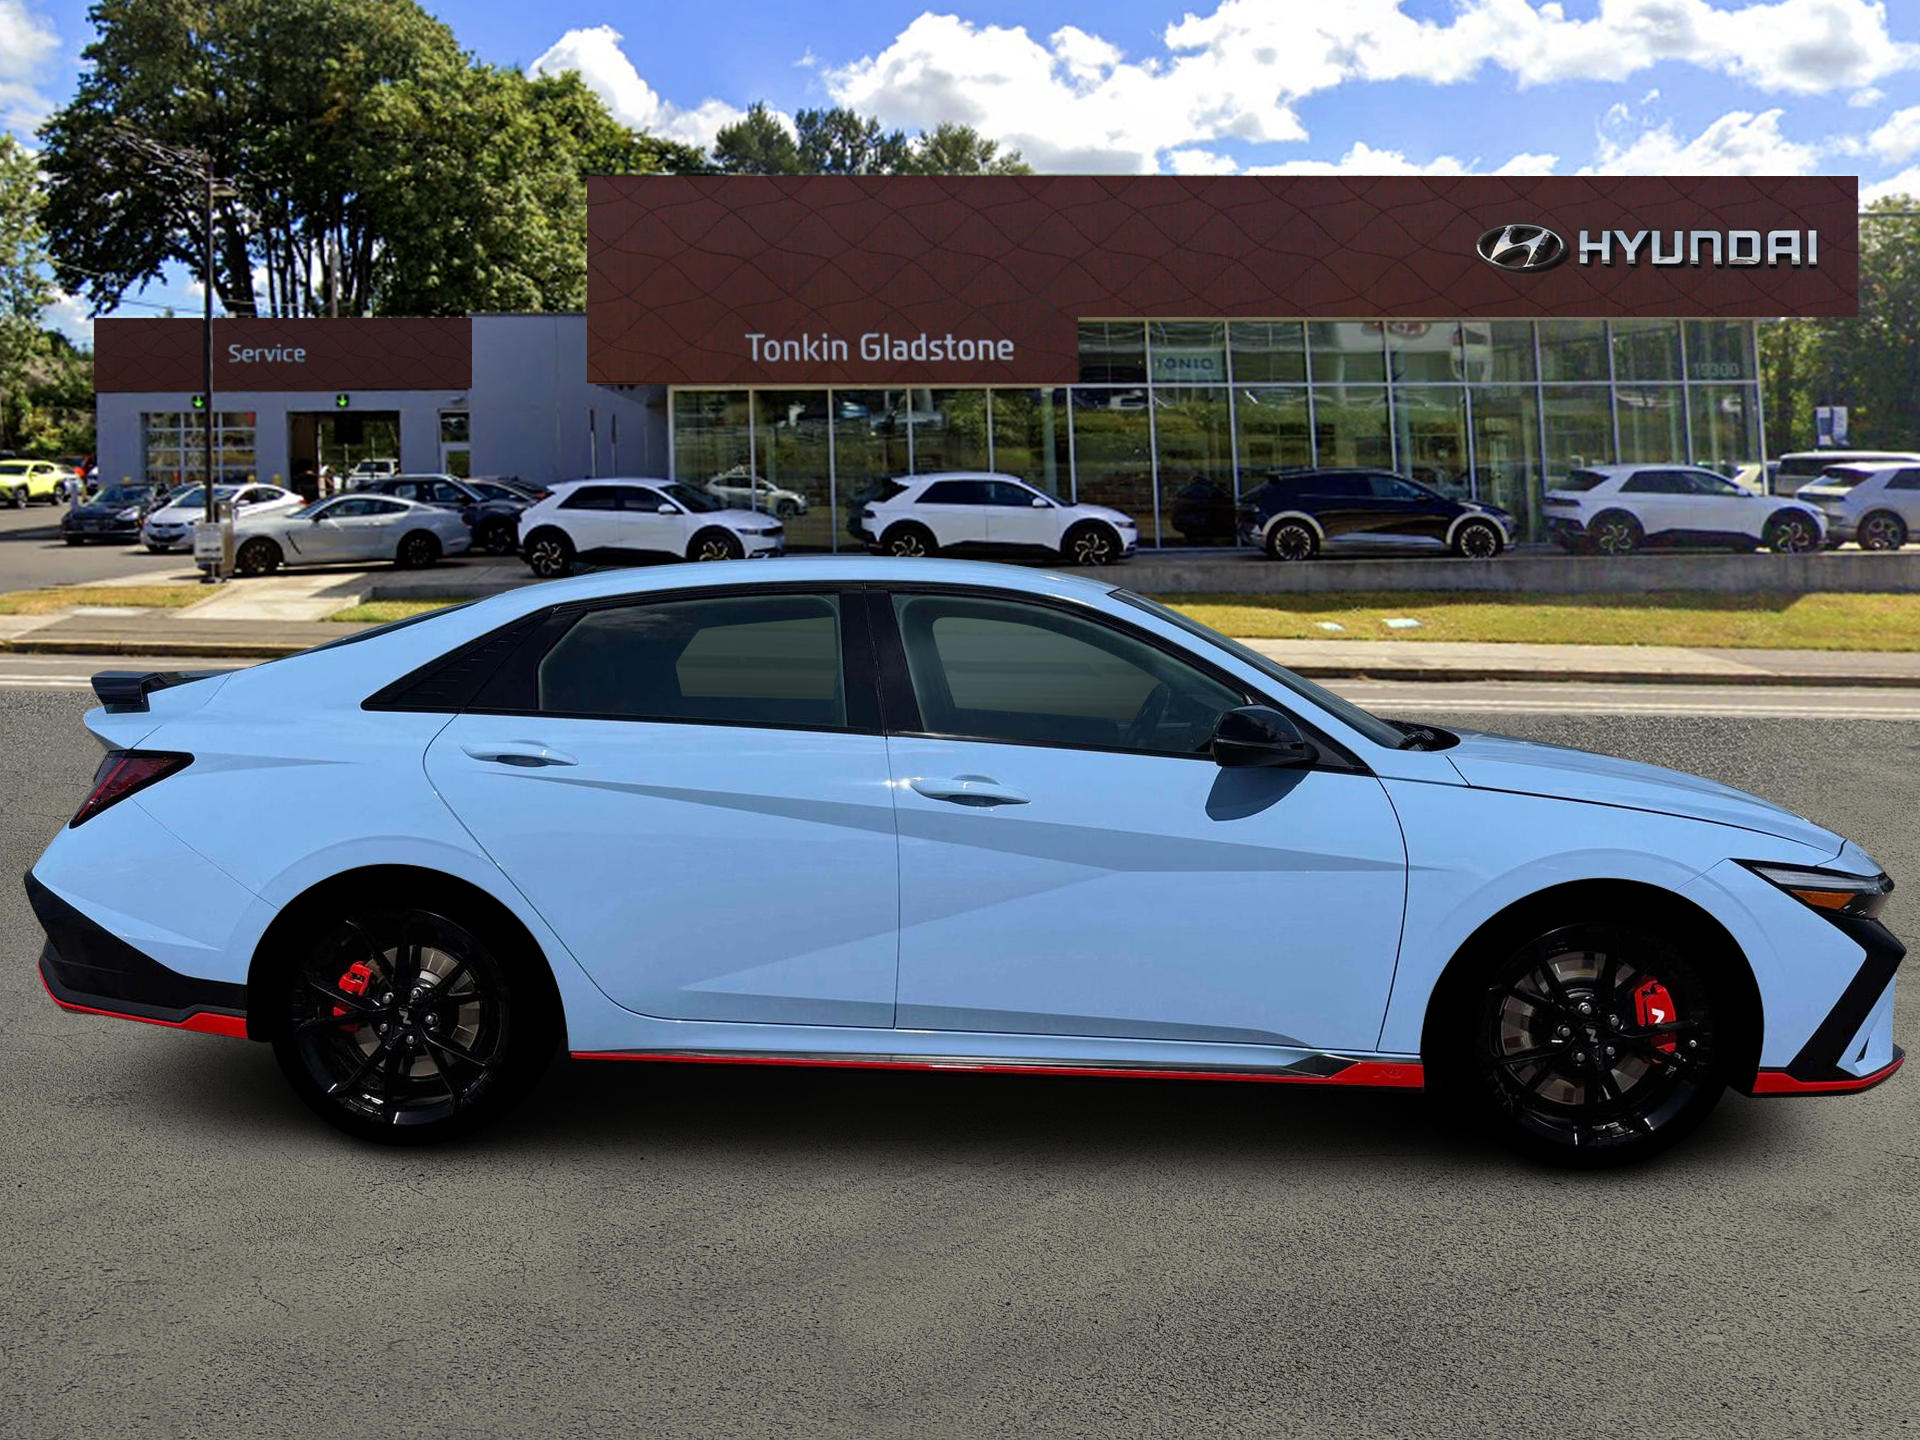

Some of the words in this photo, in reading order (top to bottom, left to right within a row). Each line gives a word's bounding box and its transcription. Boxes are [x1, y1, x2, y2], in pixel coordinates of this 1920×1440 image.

[1579, 230, 1817, 265] HYUNDAI
[228, 343, 306, 363] Service
[745, 333, 848, 362] Tonkin
[860, 333, 1014, 362] Gladstone
